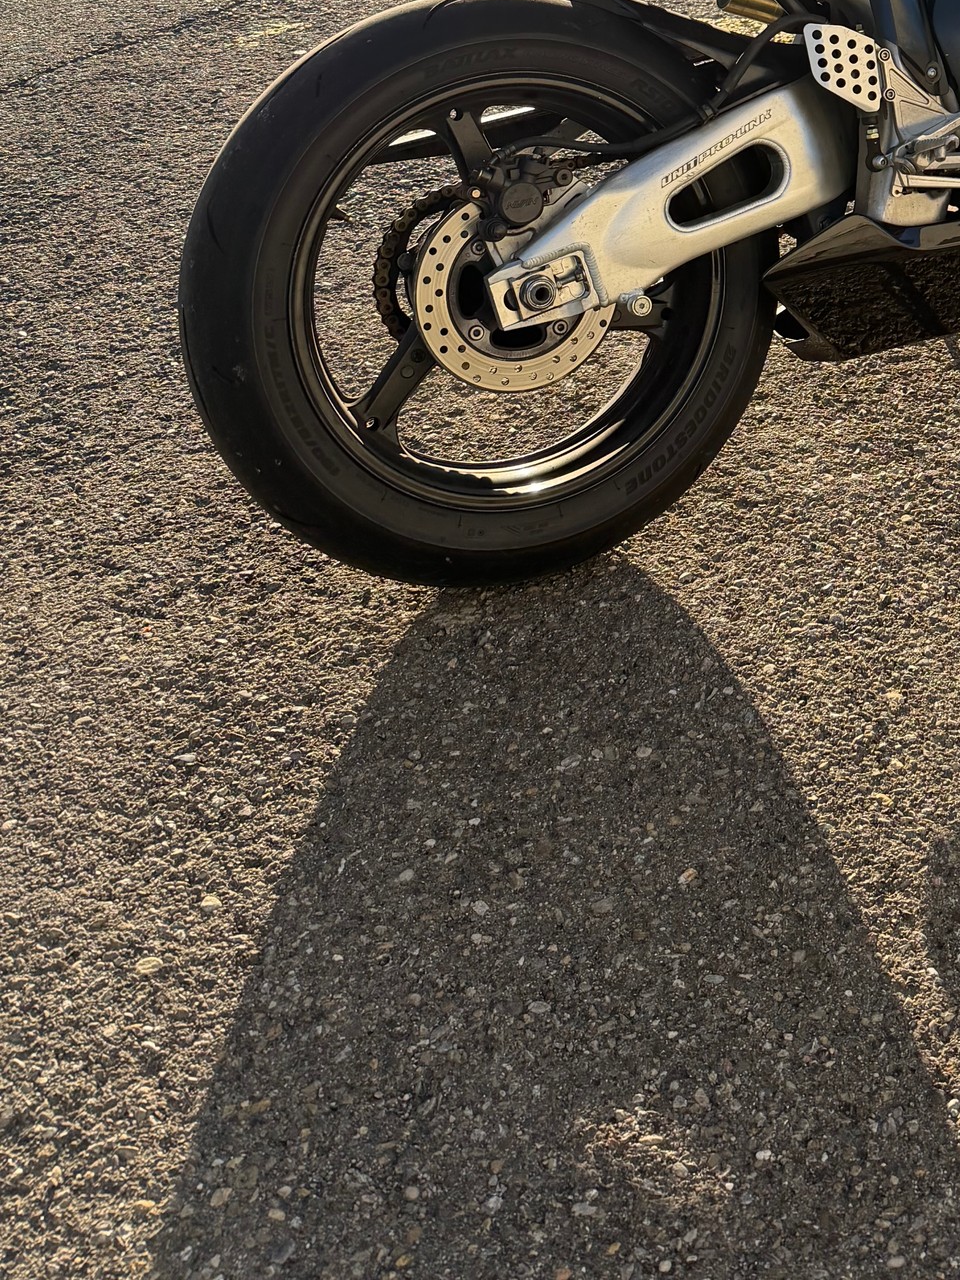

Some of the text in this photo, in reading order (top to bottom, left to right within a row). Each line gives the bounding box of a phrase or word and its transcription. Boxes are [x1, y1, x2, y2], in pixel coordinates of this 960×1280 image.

[661, 109, 772, 188] UNIT PRO-LINK
[624, 344, 737, 496] BRIDGESTONE
